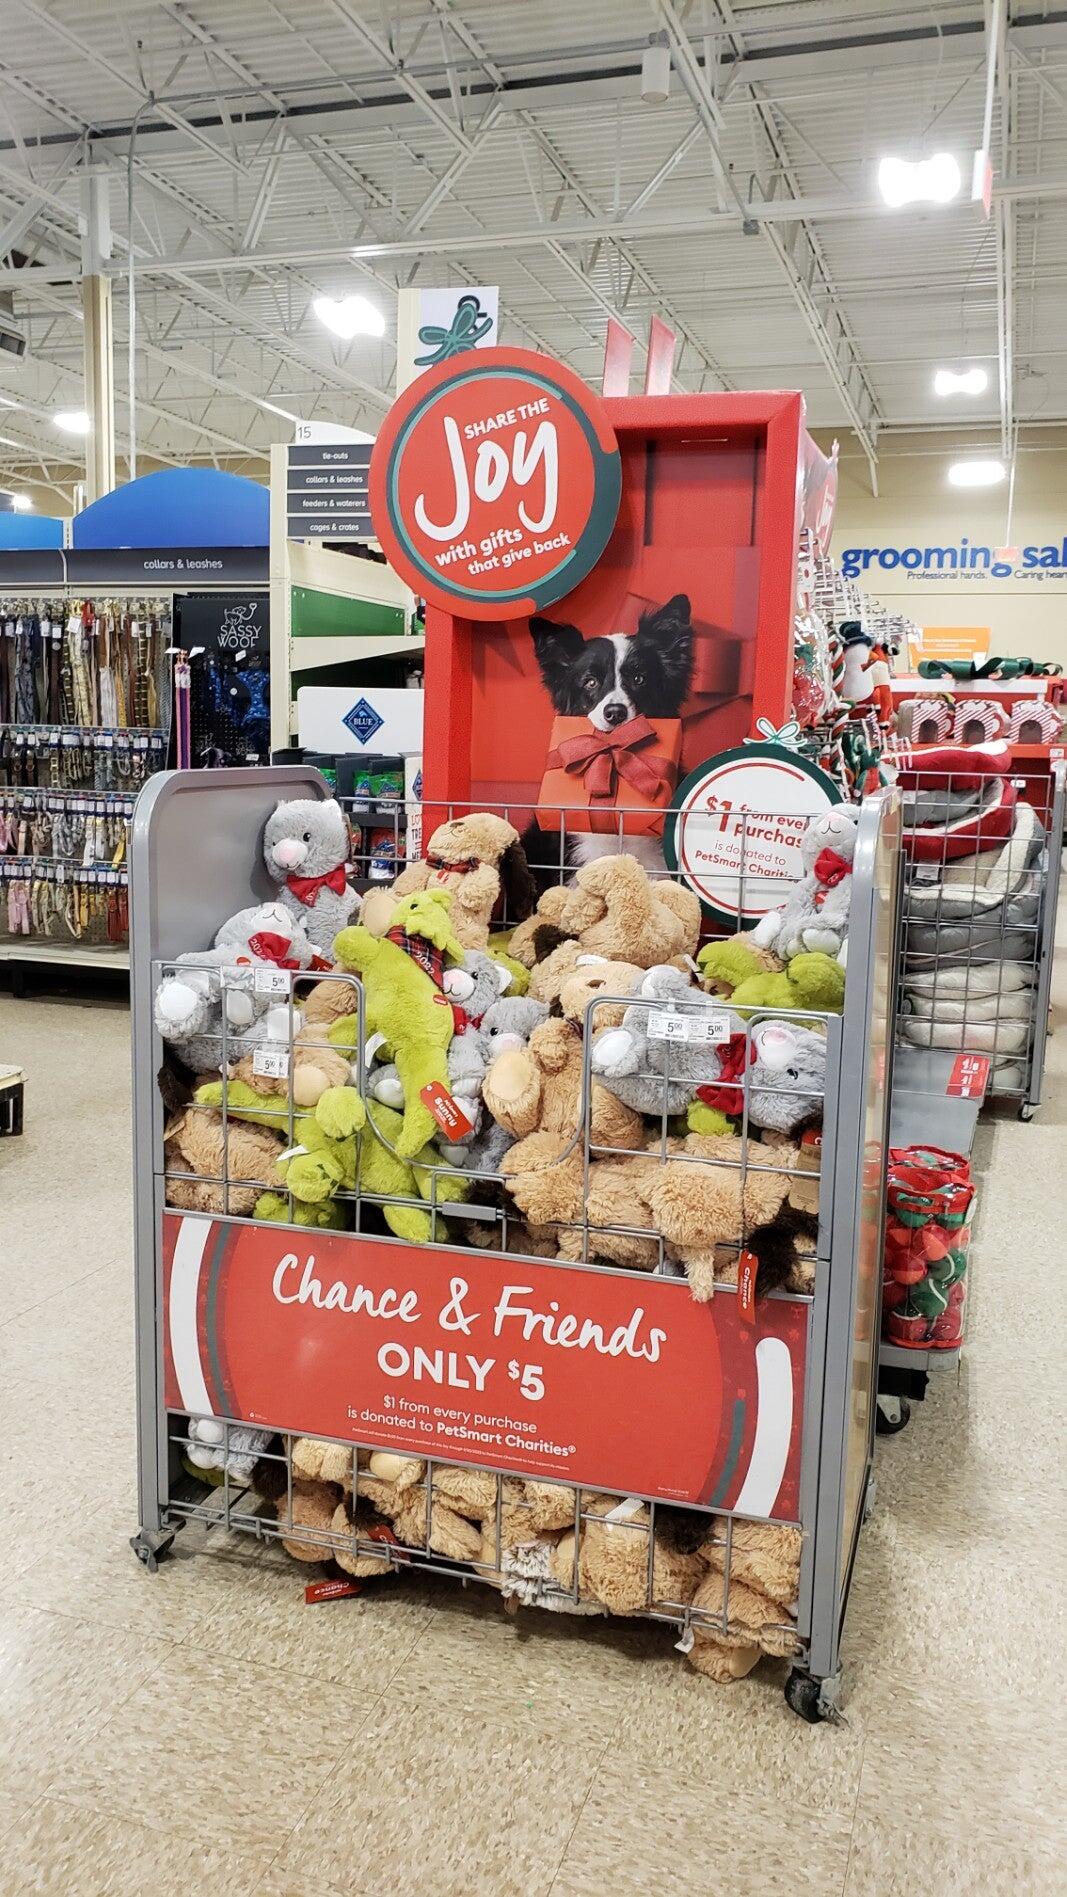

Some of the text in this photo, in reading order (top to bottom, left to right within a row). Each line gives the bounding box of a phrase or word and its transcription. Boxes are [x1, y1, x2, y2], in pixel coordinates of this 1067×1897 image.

[464, 398, 550, 440] SHARE THE
[297, 426, 312, 439] 15
[322, 451, 349, 460] tie-outs
[305, 474, 363, 484] collars & leashes
[302, 499, 366, 507] feeders & waterers
[309, 523, 360, 533] cages & crates
[434, 528, 523, 567] with gifts
[467, 532, 572, 575] that give back
[143, 558, 223, 569] collars & leashes
[907, 570, 958, 580] Professional
[220, 625, 262, 639] SASSY
[353, 717, 374, 726] BLUE
[714, 840, 723, 851] is
[774, 855, 787, 866] to
[434, 1097, 457, 1128] Bunny
[742, 1267, 750, 1309] Chance
[272, 1253, 667, 1363] Chance & Friends
[377, 1342, 546, 1401] ONLY $5
[347, 1405, 358, 1419] is
[360, 1408, 416, 1430] donated
[420, 1418, 434, 1432] to
[436, 1421, 503, 1445] PetSmart
[383, 1394, 538, 1434] $1 from every purchase
